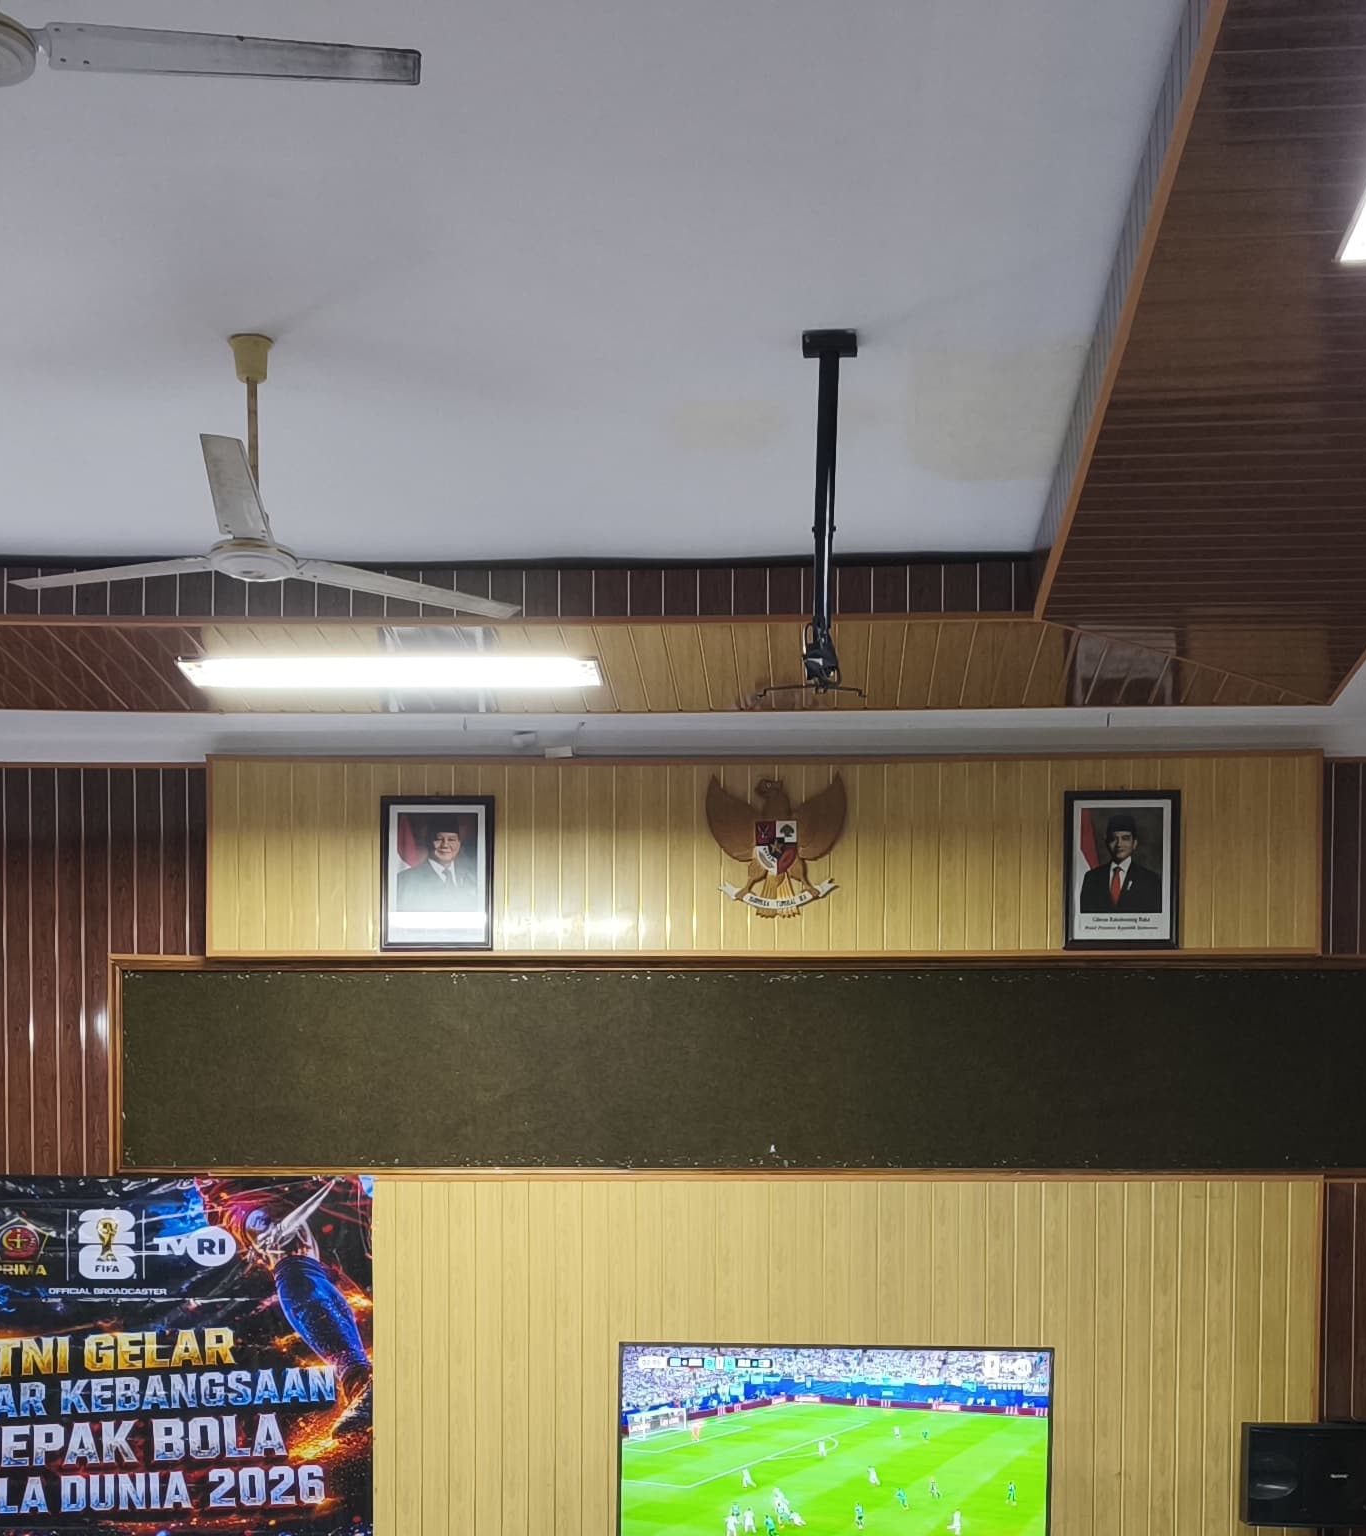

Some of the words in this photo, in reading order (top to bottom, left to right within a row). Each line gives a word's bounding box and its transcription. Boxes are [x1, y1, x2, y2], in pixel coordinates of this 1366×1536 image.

[48, 1287, 92, 1296] OFFICIAL
[93, 1287, 168, 1296] BROADCASTER
[94, 1264, 120, 1274] FIFA
[84, 1326, 237, 1373] GELAR
[60, 1365, 336, 1417] KEBANGSAAN
[152, 1412, 289, 1462] BOLA
[60, 1470, 195, 1514] DUNIA
[207, 1464, 327, 1509] 2026
